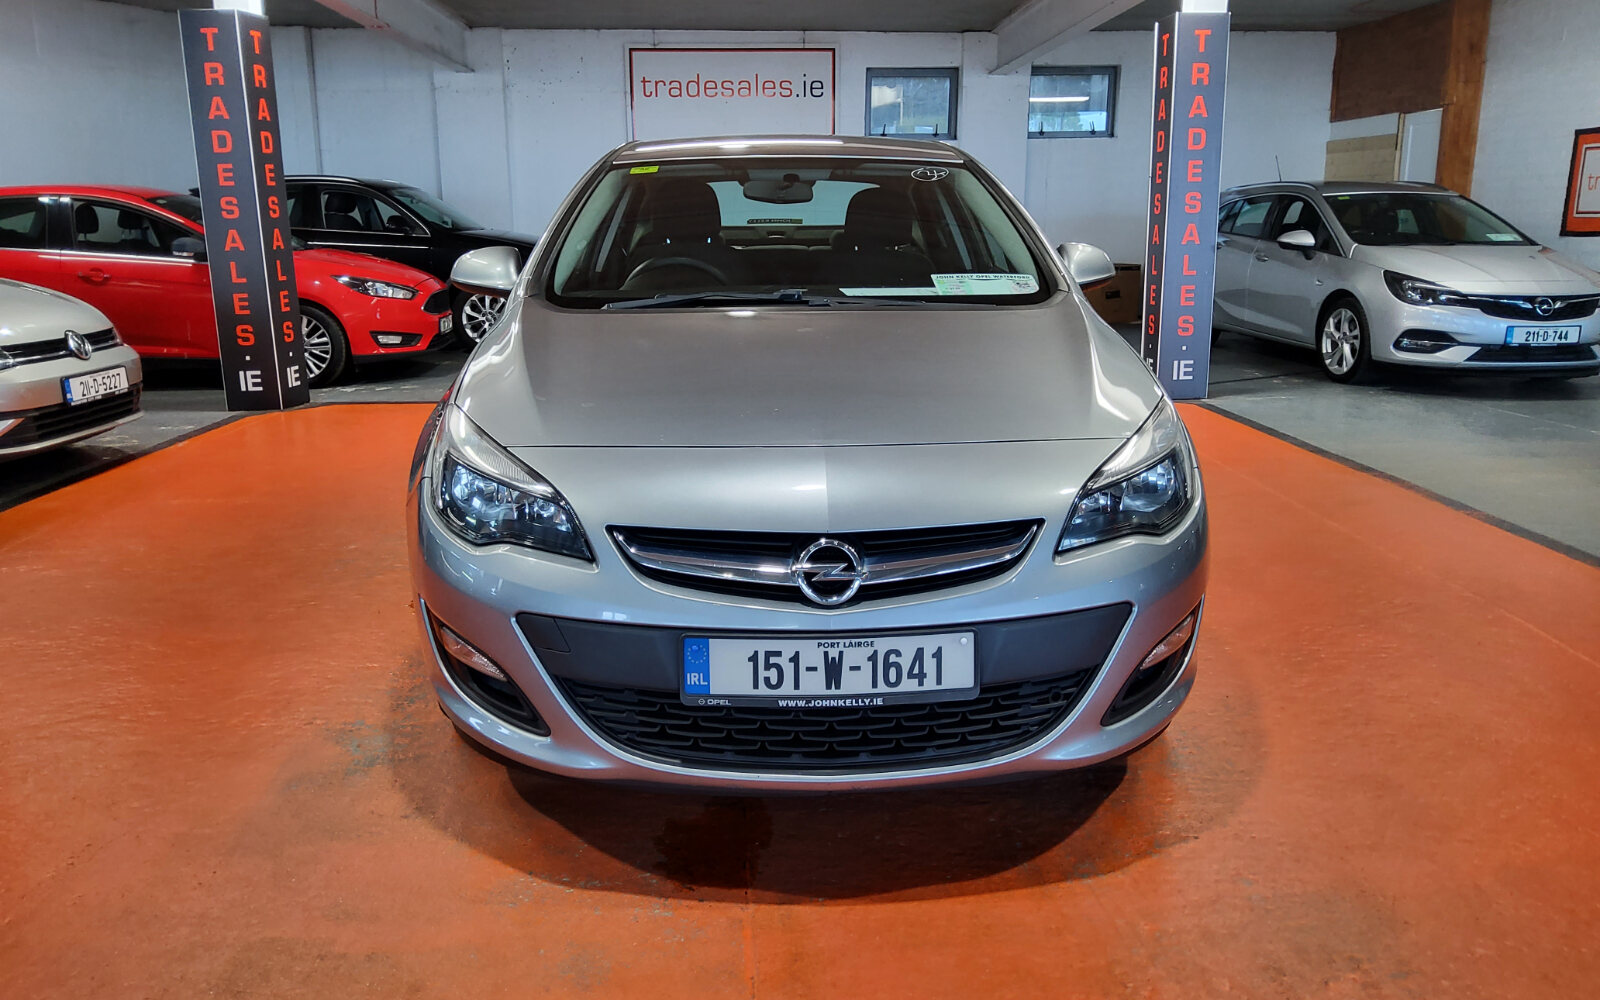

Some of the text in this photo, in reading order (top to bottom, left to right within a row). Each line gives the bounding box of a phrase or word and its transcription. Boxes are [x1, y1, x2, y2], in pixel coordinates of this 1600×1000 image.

[640, 73, 824, 98] tradesales.ie
[1525, 330, 1568, 342] 211-D-744
[80, 373, 121, 397] 211-D-5227
[817, 641, 841, 649] PORT
[748, 645, 943, 690] 151-W-1641
[686, 673, 708, 685] IRL
[778, 698, 883, 707] WWW.JOHNKELLY.IE
